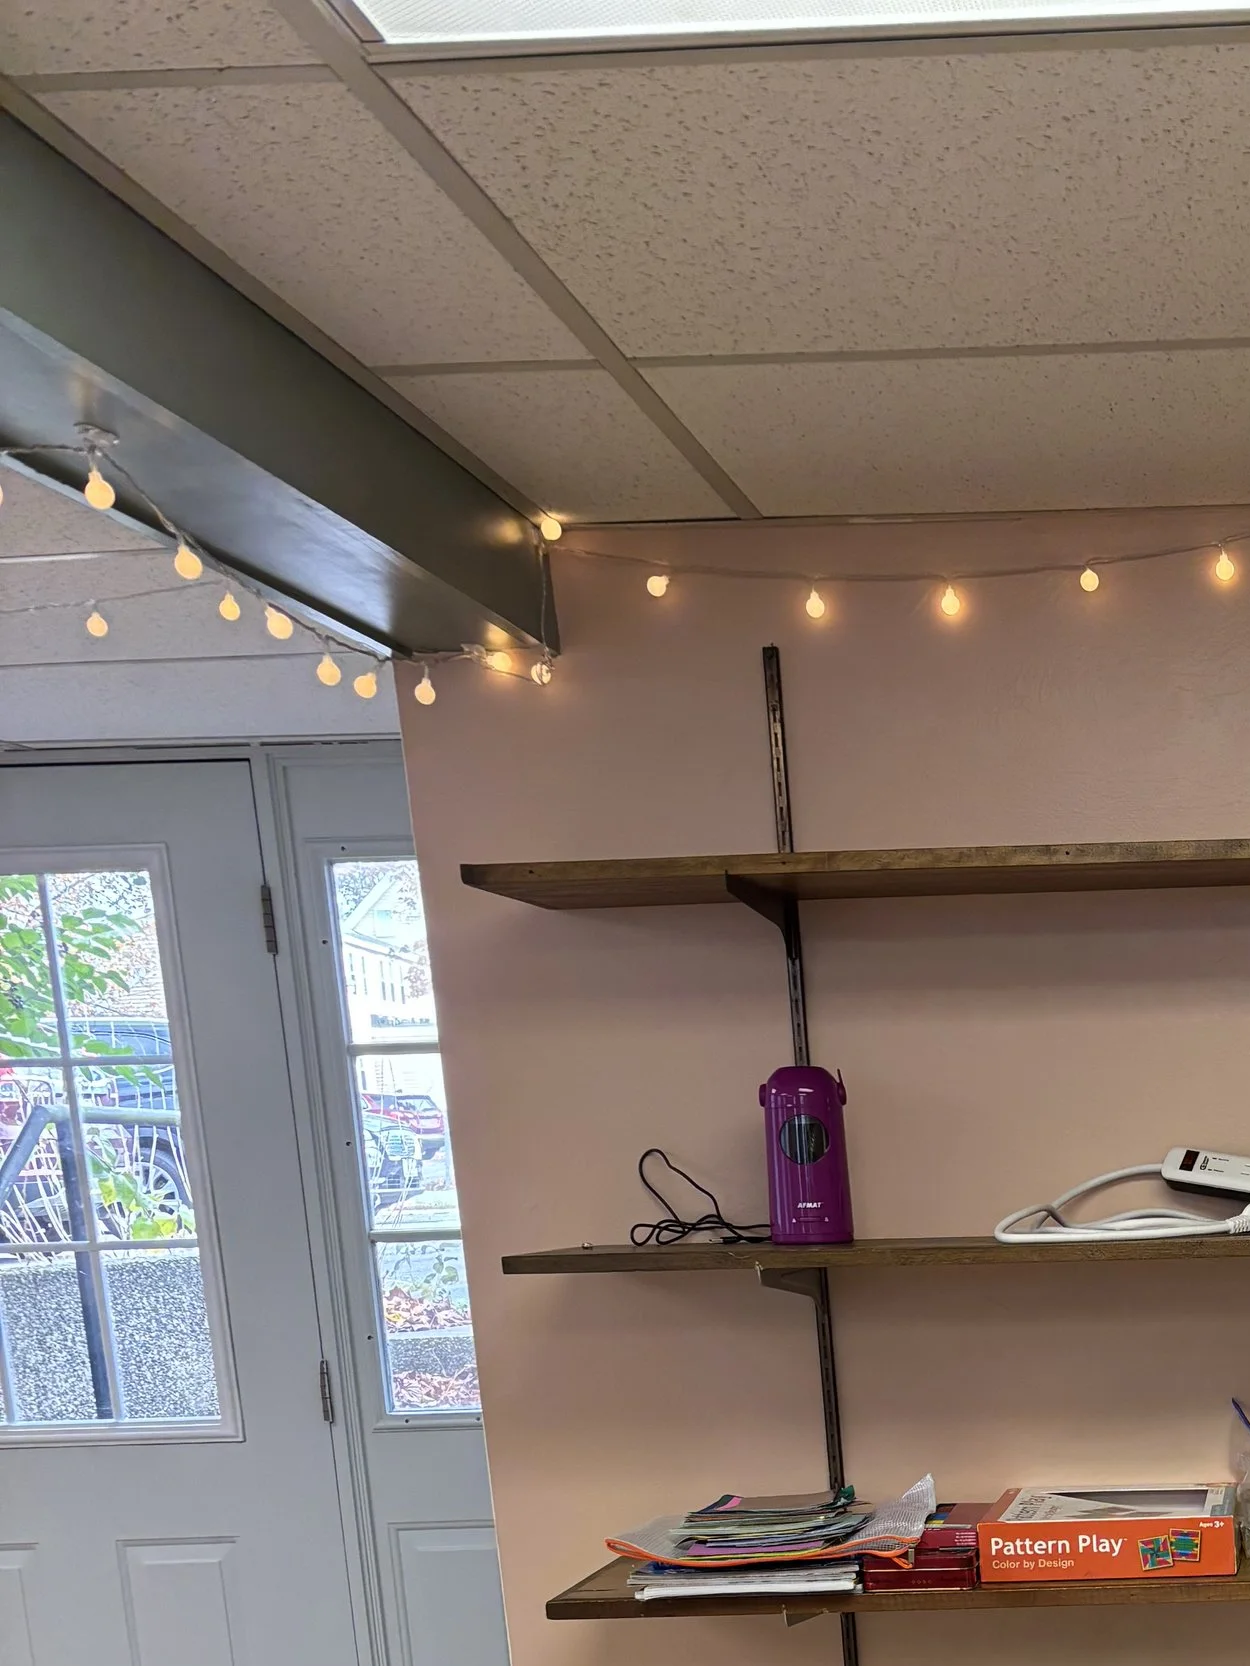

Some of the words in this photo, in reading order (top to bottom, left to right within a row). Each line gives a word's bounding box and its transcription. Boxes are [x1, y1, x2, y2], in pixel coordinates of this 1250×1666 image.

[1214, 1520, 1224, 1528] 3+
[990, 1536, 1070, 1556] Pattern
[1078, 1535, 1124, 1556] Play
[992, 1559, 1020, 1569] Color
[1023, 1558, 1036, 1570] by
[1038, 1558, 1074, 1570] Design
